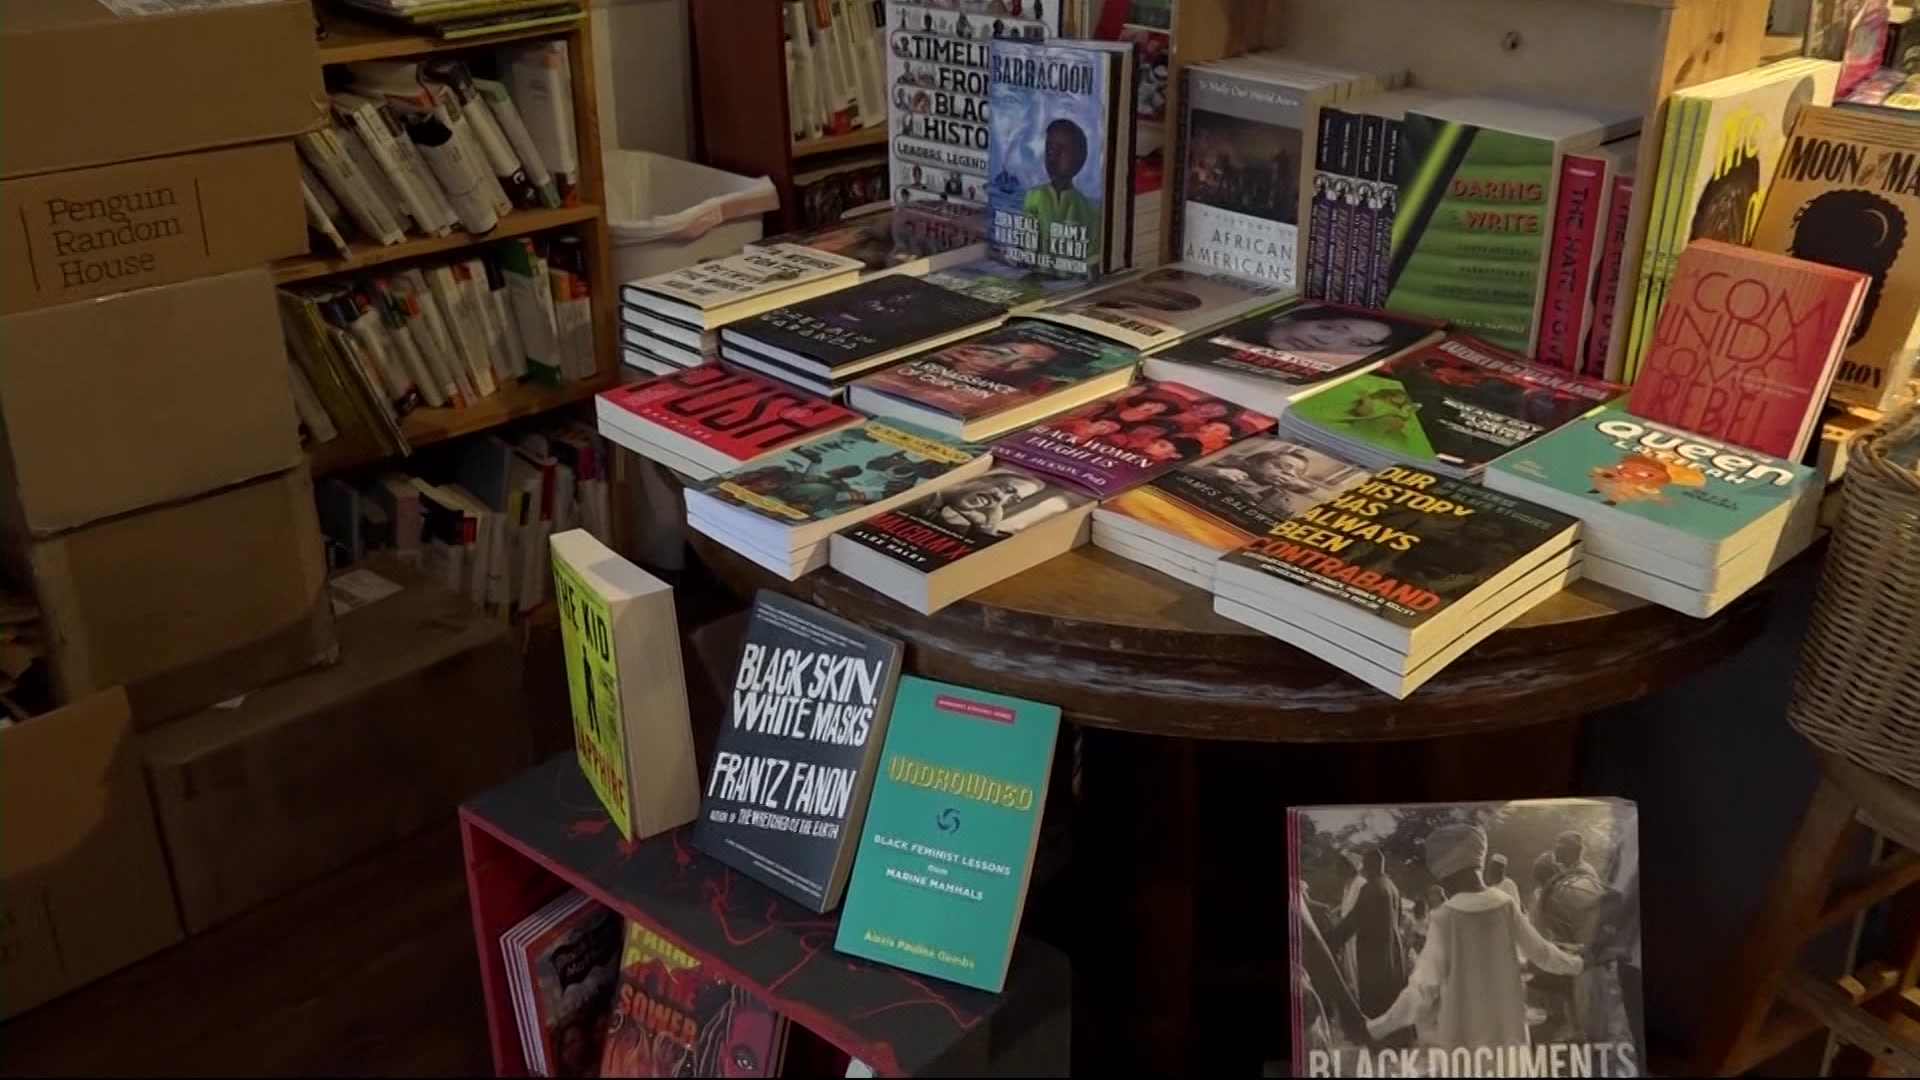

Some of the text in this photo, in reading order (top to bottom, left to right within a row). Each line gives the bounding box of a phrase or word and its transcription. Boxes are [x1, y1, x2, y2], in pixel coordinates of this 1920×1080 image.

[911, 36, 990, 67] TIMELI
[939, 67, 990, 96] FRO
[993, 54, 1094, 95] BARRACOON
[935, 92, 990, 123] BLAC
[923, 117, 990, 149] HISTO
[946, 155, 990, 171] LEGEND
[1781, 135, 1868, 184] MOON
[1880, 150, 1920, 197] MA
[48, 186, 177, 224] Penguin
[1451, 178, 1542, 201] DARING
[53, 215, 181, 257] Random
[1465, 209, 1538, 233] WRITE
[1185, 242, 1292, 283] AMERICANS
[1211, 229, 1292, 260] AFRICAN
[58, 252, 155, 289] House
[618, 363, 856, 449] PUSH
[1026, 436, 1093, 462] TAUGHT
[1081, 437, 1153, 469] WOMEN
[1376, 465, 1437, 490] OUR
[1331, 494, 1389, 517] HAS
[1357, 480, 1477, 516] HISTORY
[854, 530, 928, 563] ALEX HALEY
[863, 511, 971, 560] MALCOLM X
[1268, 519, 1355, 553] BEEN
[1303, 506, 1422, 552] ALWAYS
[1243, 536, 1441, 612] CONTRABAND
[581, 597, 610, 663] KID
[735, 642, 884, 705] BLACK SKIN,
[732, 689, 873, 748] WHITE MASKS
[708, 751, 857, 819] FRANTZ FANON
[889, 752, 1034, 811] UNDROWNED
[873, 834, 1012, 876] BLACK FEMINIST LESSONS
[886, 868, 984, 901] MARINE MAMMALS
[619, 983, 697, 1045] SOWER
[1309, 1042, 1640, 1078] BLACK DOCUMENTS
